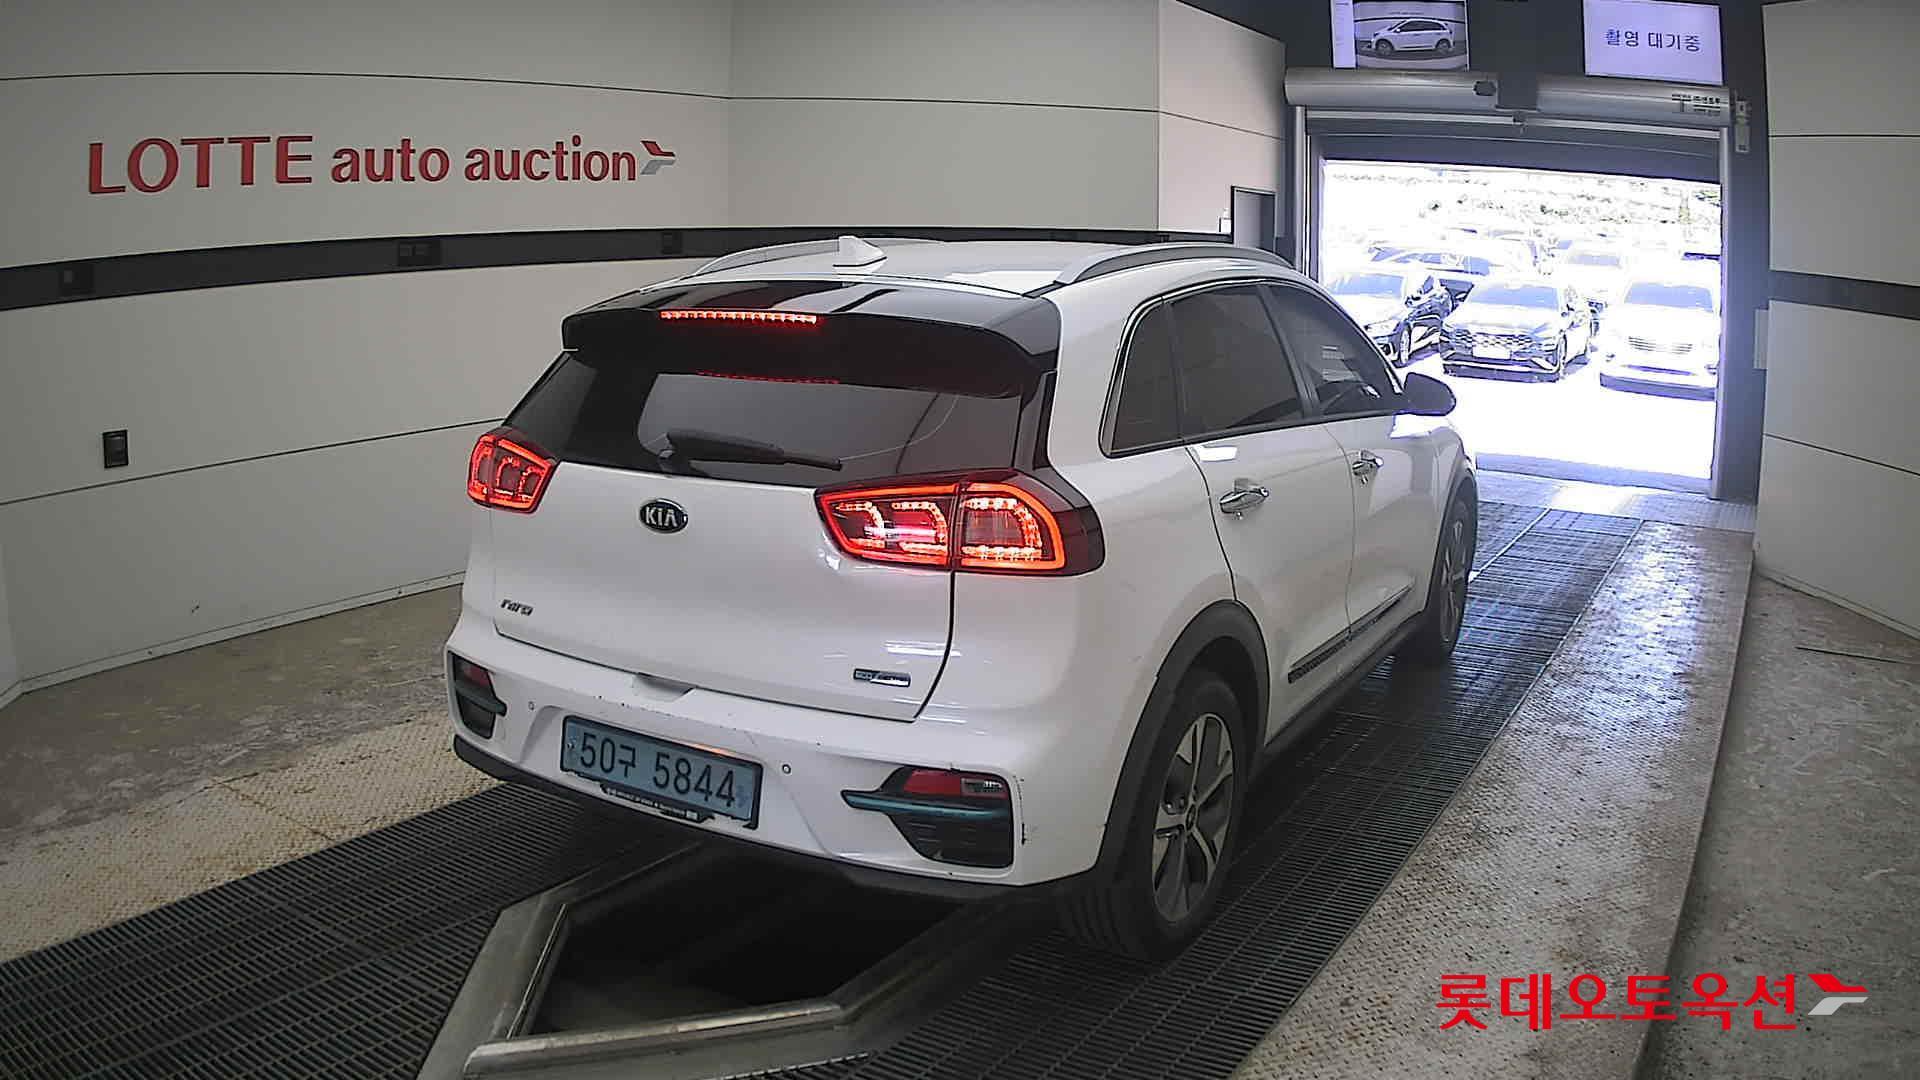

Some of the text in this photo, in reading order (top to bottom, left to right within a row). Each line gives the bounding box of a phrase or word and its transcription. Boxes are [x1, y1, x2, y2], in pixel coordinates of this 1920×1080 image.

[1648, 32, 1700, 51] 대기중
[88, 135, 637, 194] LOTTE auto auction
[645, 506, 678, 527] KIA
[580, 732, 636, 778] 50구
[653, 751, 736, 807] 5844
